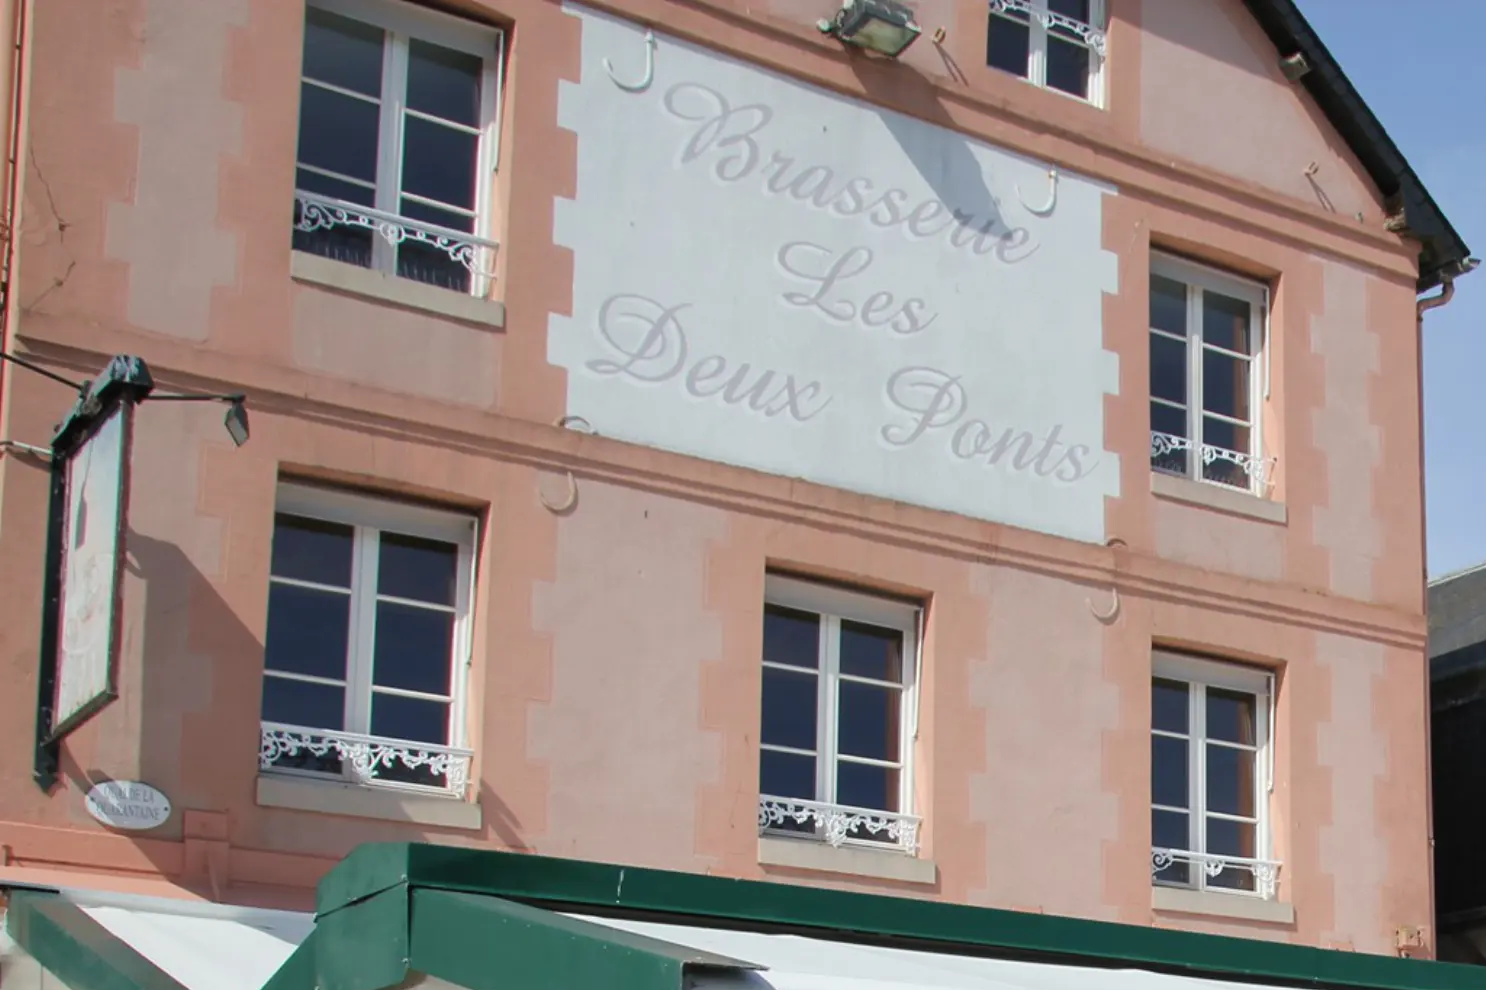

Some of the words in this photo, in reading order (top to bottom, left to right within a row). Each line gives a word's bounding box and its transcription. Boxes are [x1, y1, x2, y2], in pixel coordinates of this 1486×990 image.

[663, 80, 1041, 265] Brasserie
[776, 240, 939, 335] Les
[585, 293, 833, 422] Deux
[880, 365, 1100, 483] Ponts
